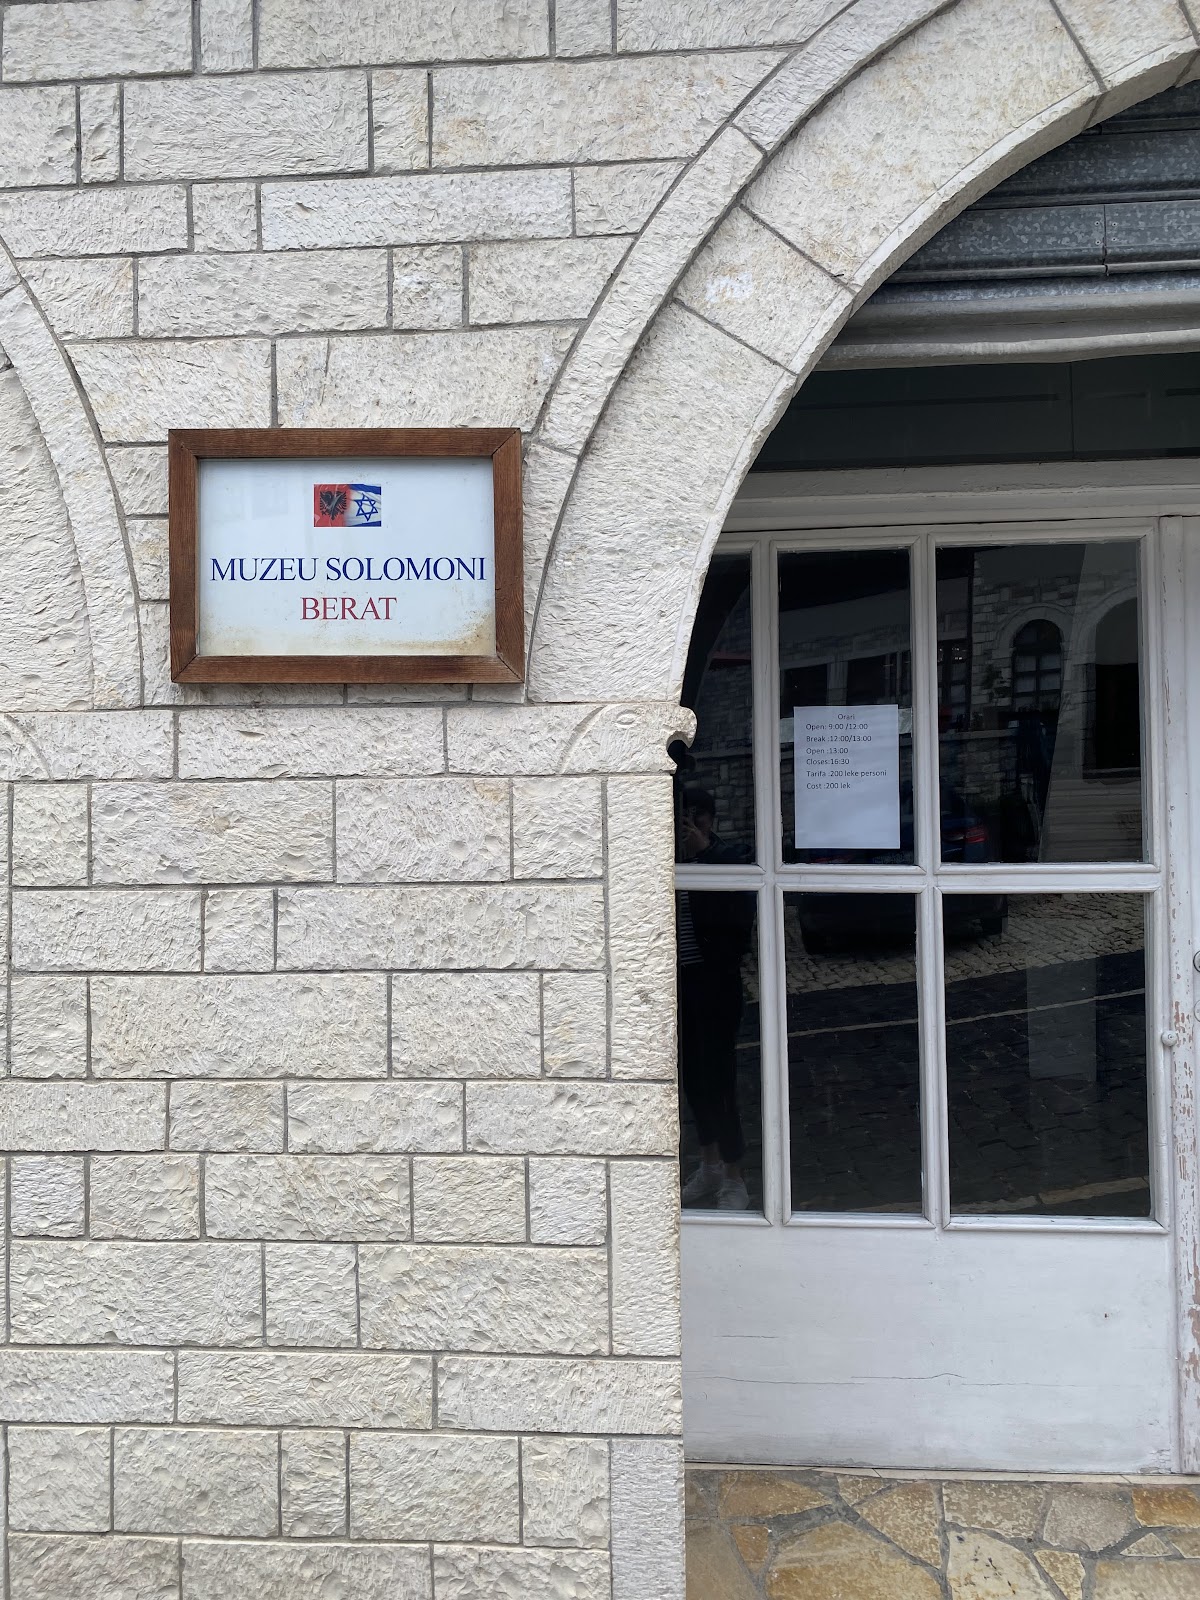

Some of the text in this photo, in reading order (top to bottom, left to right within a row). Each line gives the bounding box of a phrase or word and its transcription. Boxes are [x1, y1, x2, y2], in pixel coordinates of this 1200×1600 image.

[210, 557, 487, 582] MUZEU SOLOMONI
[299, 596, 398, 621] BERAT
[806, 723, 827, 731] Open:
[806, 747, 825, 755] Open
[844, 769, 859, 777] leke
[860, 769, 887, 778] personi
